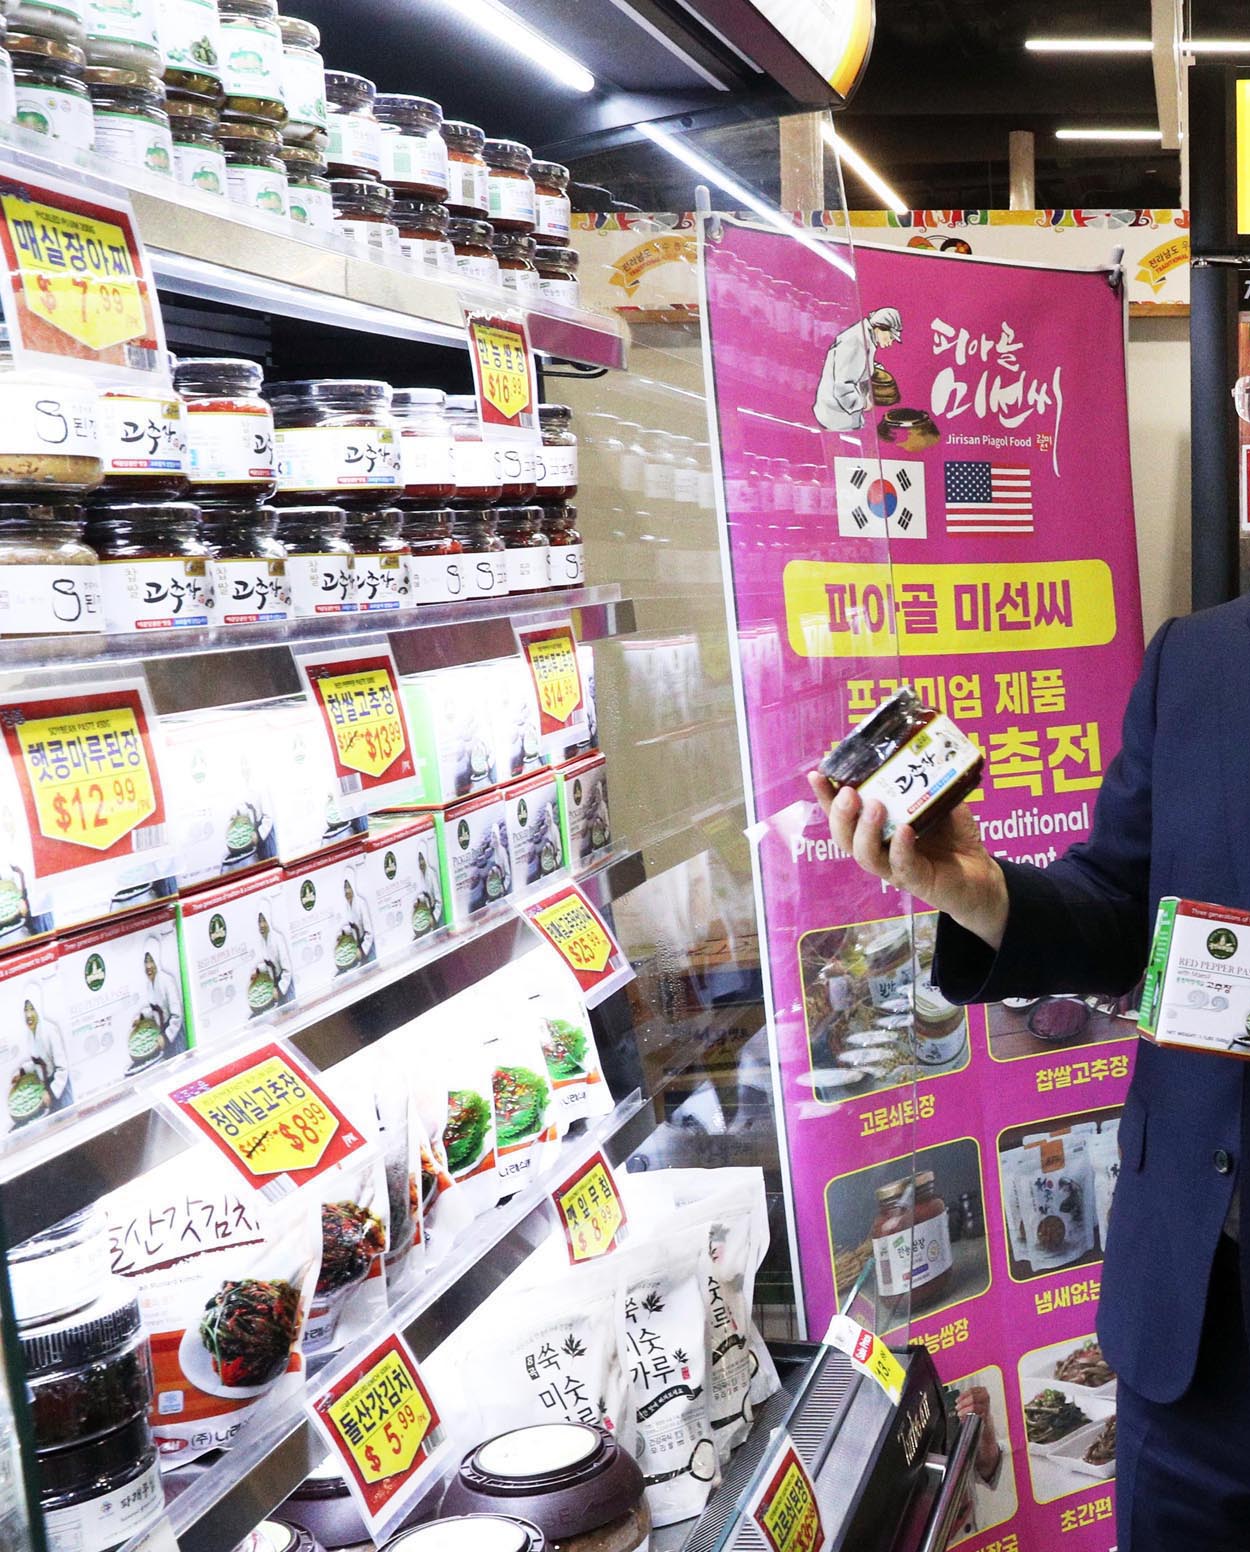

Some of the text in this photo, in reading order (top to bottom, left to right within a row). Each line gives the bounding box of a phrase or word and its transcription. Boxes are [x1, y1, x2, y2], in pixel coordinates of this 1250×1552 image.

[12, 219, 131, 276] 매실장아찌
[1148, 245, 1179, 269] 전라남도
[930, 317, 1024, 370] 피아골
[930, 365, 1063, 478] 미선씨
[945, 432, 1032, 449] Jirisan Piagol Food
[825, 579, 1074, 634] 피아골 미선씨
[327, 685, 394, 724] 찹쌀고추장
[995, 668, 1066, 715] 제품
[28, 729, 141, 782] 햇콩마루된장
[53, 777, 136, 832] $12.99
[1179, 958, 1198, 967] RED
[1200, 961, 1235, 974] PEPPER
[1206, 981, 1232, 994] 고추장
[1036, 1055, 1129, 1092] 찹쌀고추장
[209, 1071, 305, 1136] 청매실고추장
[859, 1094, 935, 1136] 고로쇠된장
[567, 1175, 612, 1229] 깻잎무침
[537, 1342, 561, 1371] 쑥
[629, 1355, 675, 1390] 가루
[339, 1365, 413, 1446] 돌산갓김치
[538, 1376, 589, 1410] 미숫
[1060, 1497, 1112, 1533] 초간편
